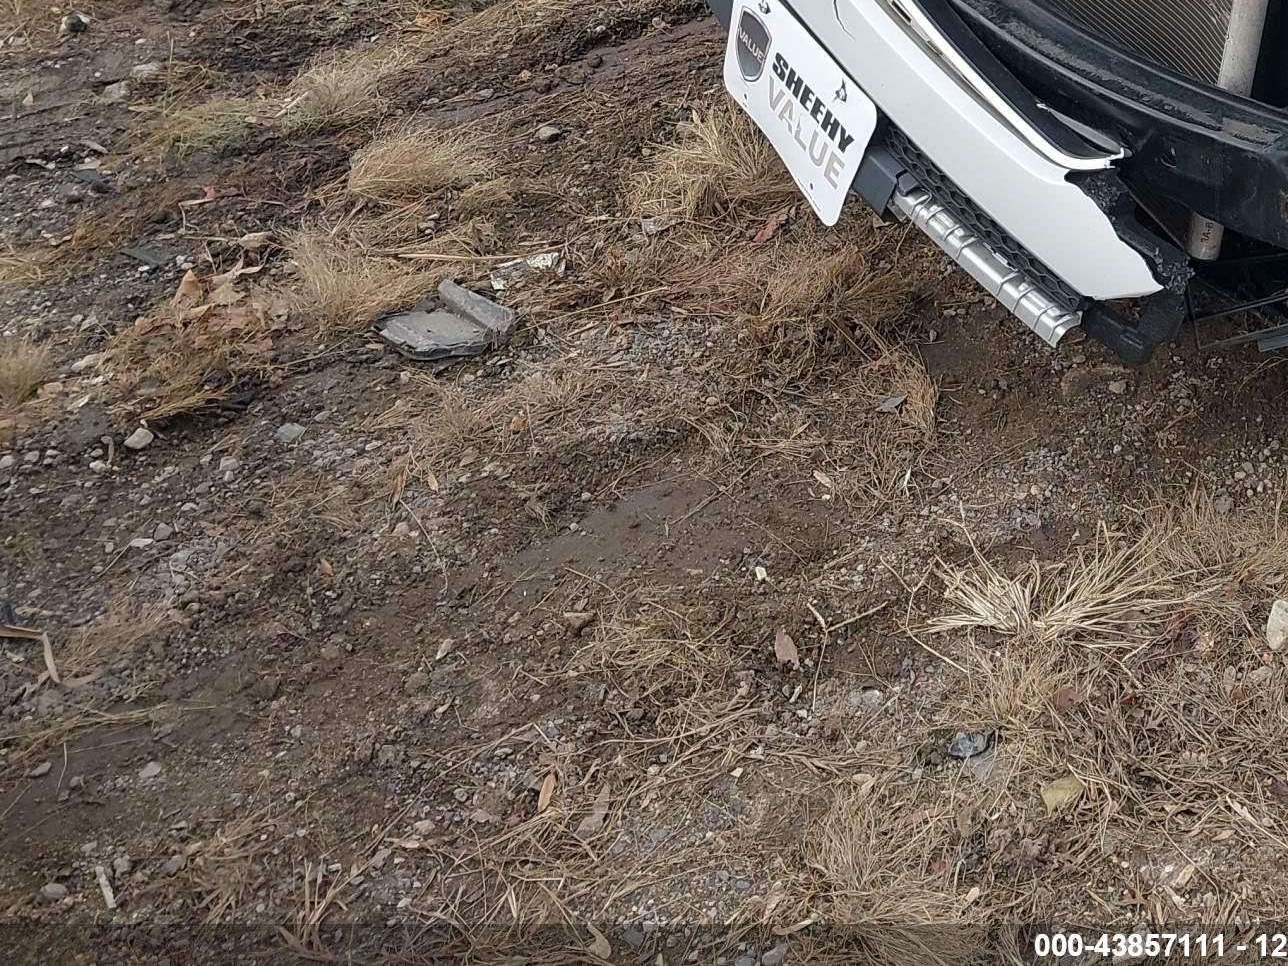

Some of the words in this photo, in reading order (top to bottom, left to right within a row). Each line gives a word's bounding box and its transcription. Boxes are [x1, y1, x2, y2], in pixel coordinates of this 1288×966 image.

[737, 26, 766, 64] VALUE
[768, 75, 846, 191] VALUE
[772, 52, 856, 153] SHEEHY
